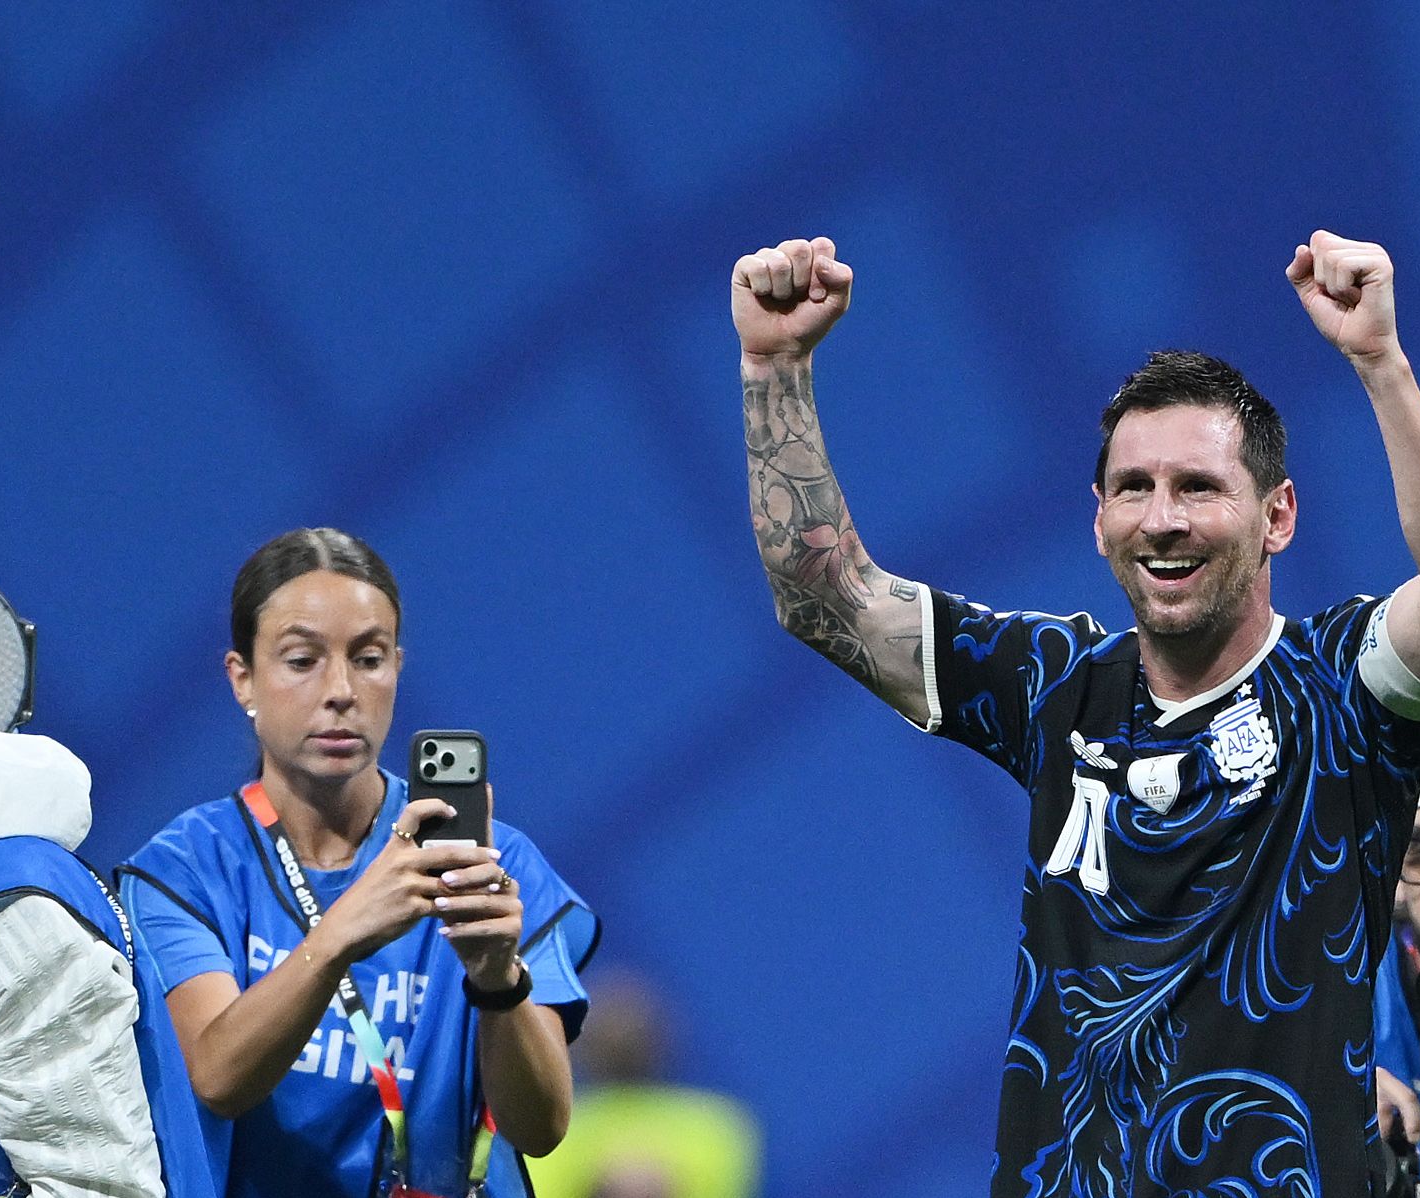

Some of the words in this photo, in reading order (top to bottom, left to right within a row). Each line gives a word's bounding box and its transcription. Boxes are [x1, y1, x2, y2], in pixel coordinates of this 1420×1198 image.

[1226, 721, 1261, 757] AFA
[1144, 785, 1167, 797] FIFA
[1046, 767, 1111, 897] 10
[107, 894, 133, 943] WORLD
